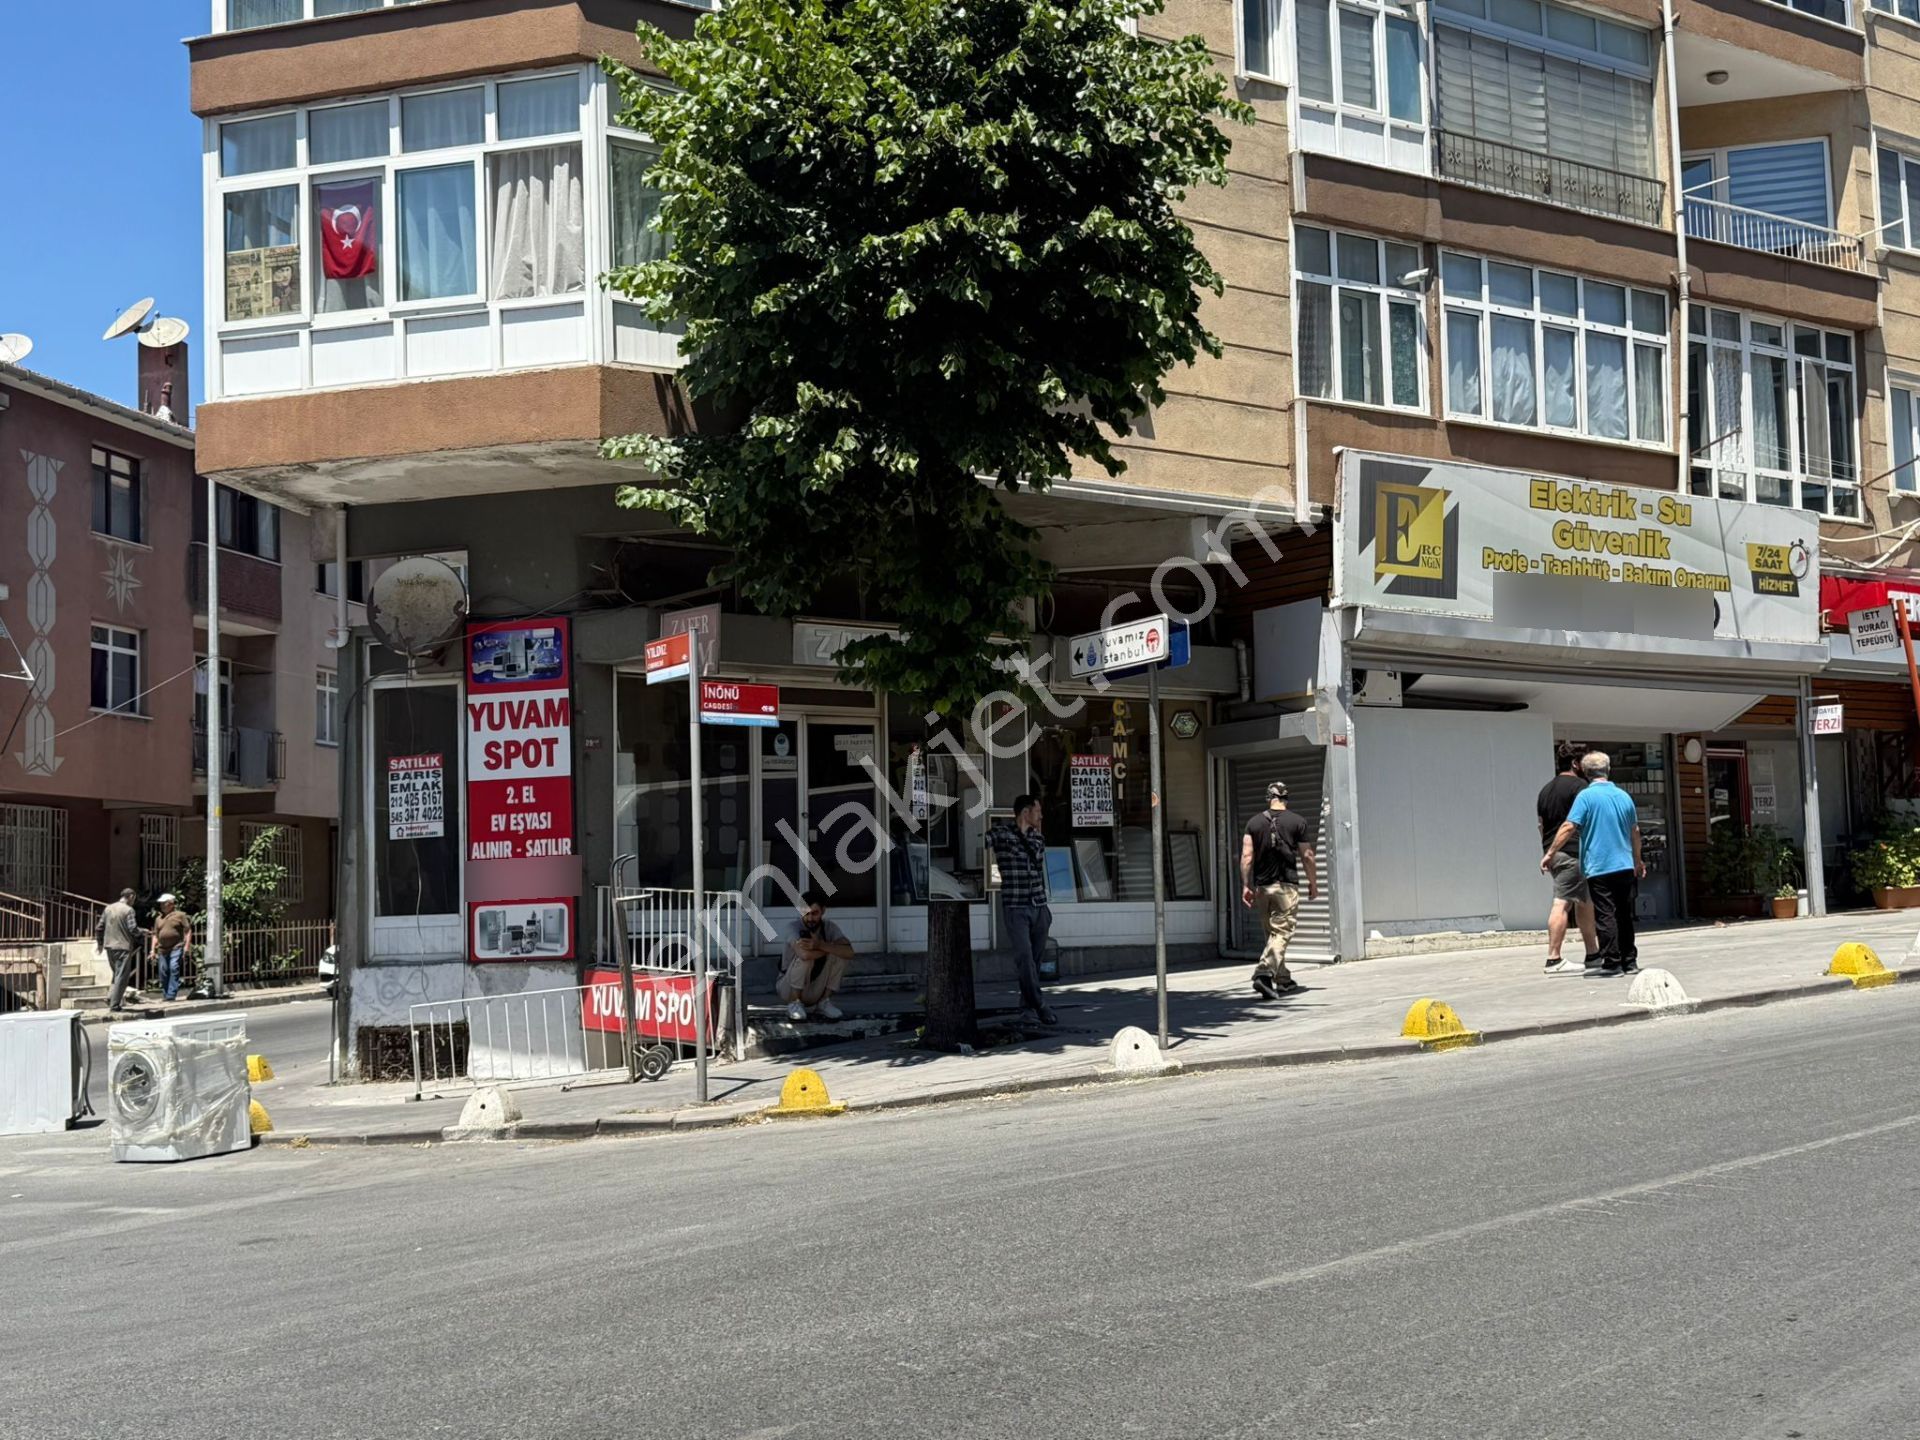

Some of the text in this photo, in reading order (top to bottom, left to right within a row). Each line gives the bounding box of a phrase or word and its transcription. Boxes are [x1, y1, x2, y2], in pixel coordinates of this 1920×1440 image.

[1530, 479, 1637, 520] Elektrik
[1657, 496, 1692, 526] Su
[1552, 519, 1671, 560] Güvenlik
[1757, 546, 1781, 559] 7/24
[1482, 546, 1529, 574] Proje
[1541, 553, 1610, 581] Taahhüt
[1622, 561, 1672, 587] Bakım
[1674, 567, 1731, 592] Onarım
[1755, 557, 1783, 570] SAAT
[1759, 575, 1794, 592] HİZMET
[1857, 619, 1890, 633] DURAĞI
[1856, 633, 1894, 648] TEPEÜSTÜ
[703, 684, 740, 700] İNÖNÜ
[468, 697, 569, 732] YUVAM
[1810, 715, 1841, 731] TERZİ
[483, 737, 559, 771] SPOT
[1072, 756, 1110, 766] SATILIK
[390, 756, 440, 770] SATILIK
[390, 769, 441, 781] BARIŞ
[1072, 777, 1110, 787] EMLAK
[390, 781, 441, 793] EMLAK
[506, 785, 536, 804] 2. EL
[391, 790, 442, 808] 212 425 6167
[422, 806, 443, 821] 4022
[491, 811, 552, 834] EV EŞYASI
[471, 840, 513, 860] ALINIR
[525, 837, 572, 857] SATILIR
[592, 984, 697, 1026] YUVM SPO
